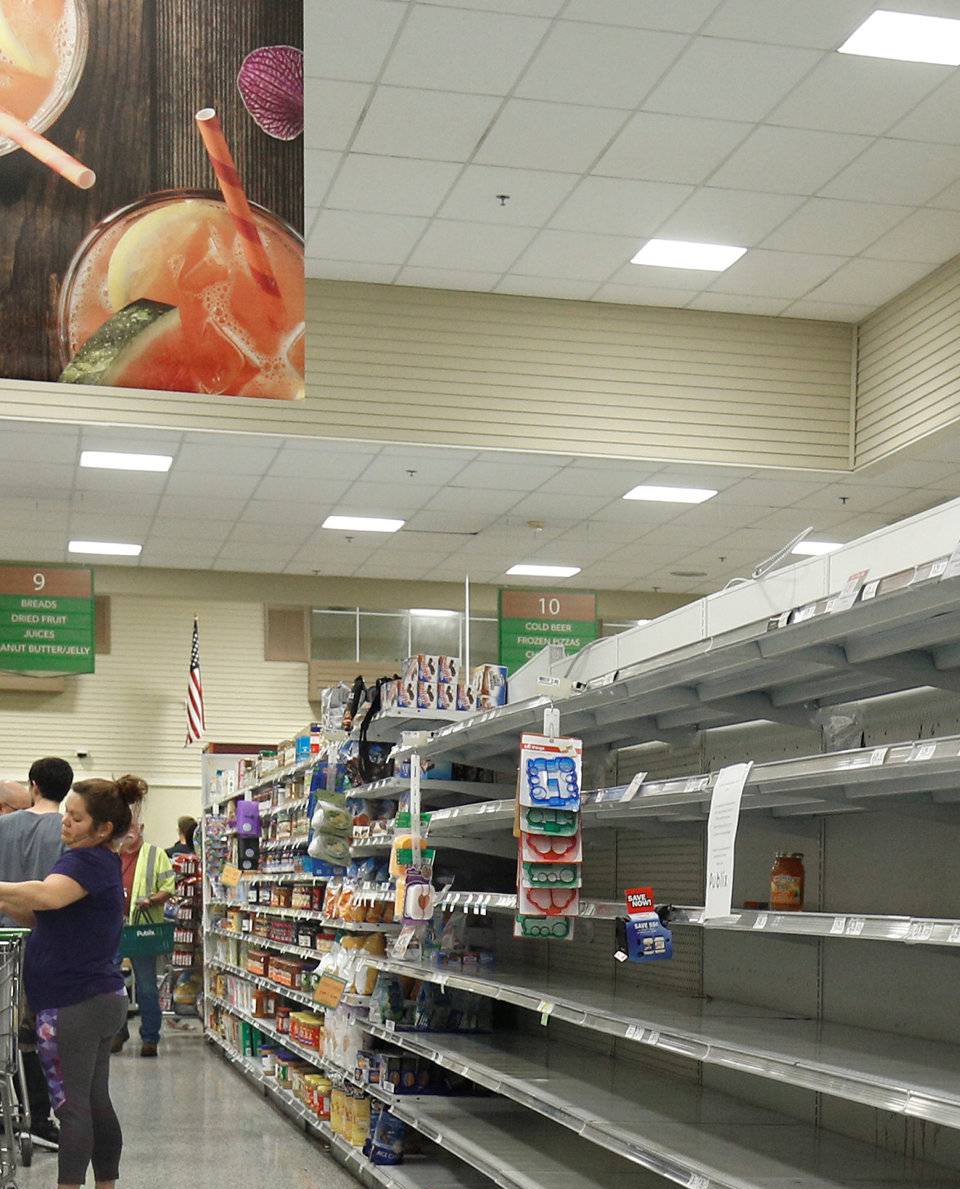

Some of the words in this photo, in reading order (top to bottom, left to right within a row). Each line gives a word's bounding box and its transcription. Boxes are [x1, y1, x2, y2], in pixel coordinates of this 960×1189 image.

[33, 573, 45, 591] 9
[21, 599, 58, 609] BREADS
[538, 597, 560, 615] 10
[11, 614, 40, 624] DRIED
[42, 614, 67, 624] FRUIT
[525, 622, 549, 631] COLD
[551, 624, 572, 632] BEER
[24, 630, 55, 639] JUICES
[517, 636, 550, 645] FROZEN
[551, 638, 581, 647] PIZZAS
[29, 645, 91, 655] BUTTER/JELLY
[709, 871, 728, 889] Publix
[627, 893, 646, 903] SAVE
[634, 922, 648, 930] SAVE
[136, 929, 156, 937] Publix
